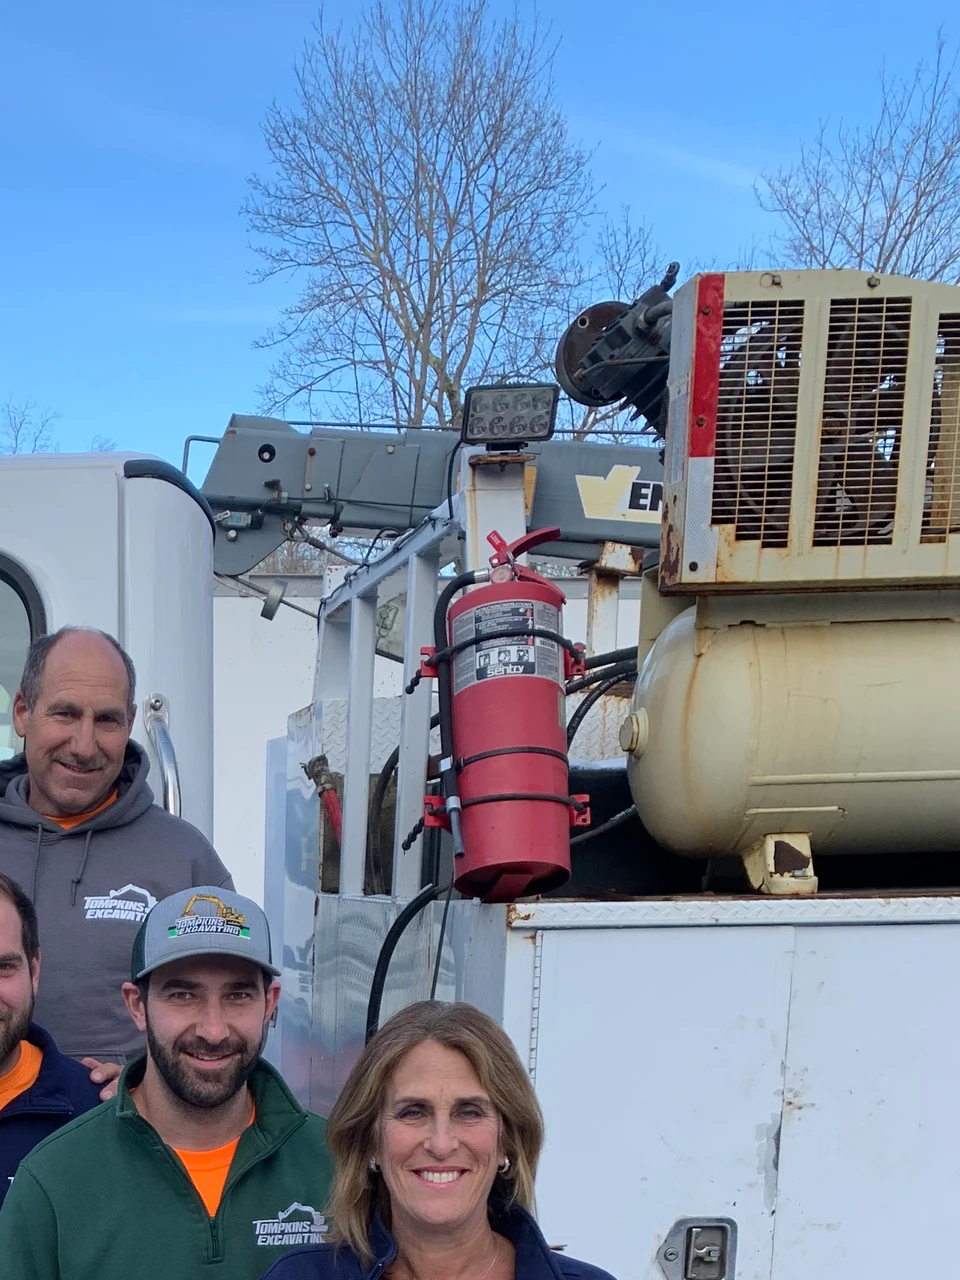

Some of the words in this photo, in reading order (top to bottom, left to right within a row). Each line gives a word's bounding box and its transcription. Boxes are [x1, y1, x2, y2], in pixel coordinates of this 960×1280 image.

[83, 896, 146, 912] TOMPKINS
[176, 916, 225, 928] TOMPKINS
[178, 925, 239, 936] EXCAVATING
[252, 1219, 311, 1235] TOMPKINS
